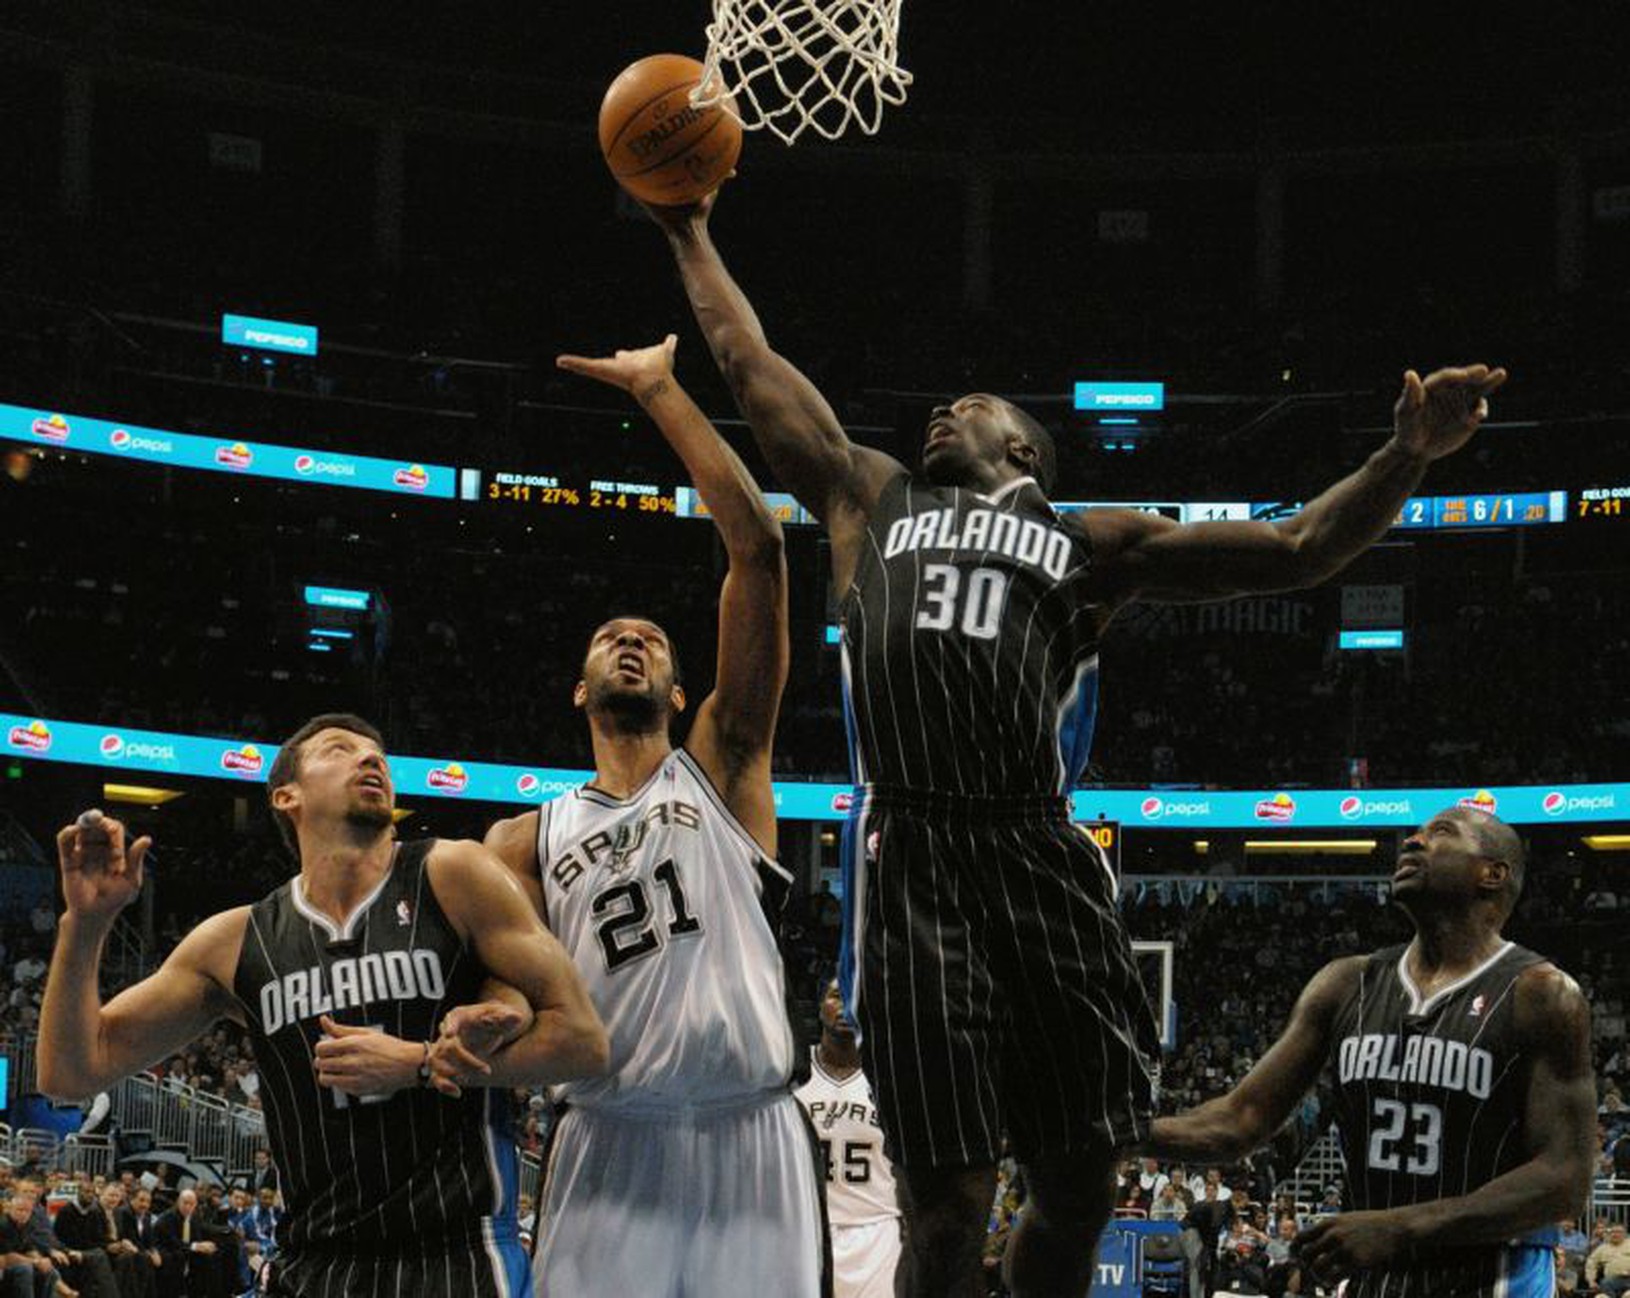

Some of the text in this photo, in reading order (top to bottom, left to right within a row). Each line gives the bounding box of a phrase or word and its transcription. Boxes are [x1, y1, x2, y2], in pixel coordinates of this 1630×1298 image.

[630, 103, 706, 156] SPALDIN
[131, 437, 173, 452] pepsi
[315, 461, 356, 476] pepsi
[542, 488, 579, 505] 27%
[639, 496, 676, 511] 50%
[1411, 502, 1424, 522] 2
[884, 508, 1072, 581] ORLANDO
[916, 563, 1006, 639] 30
[126, 743, 174, 760] pepsi
[541, 781, 585, 794] pep
[1165, 802, 1209, 816] pepsi
[1365, 798, 1411, 815] pepsi
[1568, 793, 1615, 811] pepsi
[552, 800, 701, 893] SPURS
[592, 856, 705, 976] 21
[260, 949, 446, 1036] ORLANDO
[1339, 1033, 1493, 1100] ORLANDO
[809, 1101, 881, 1130] PURS
[1368, 1098, 1442, 1176] 23
[1097, 1263, 1126, 1286] TV
